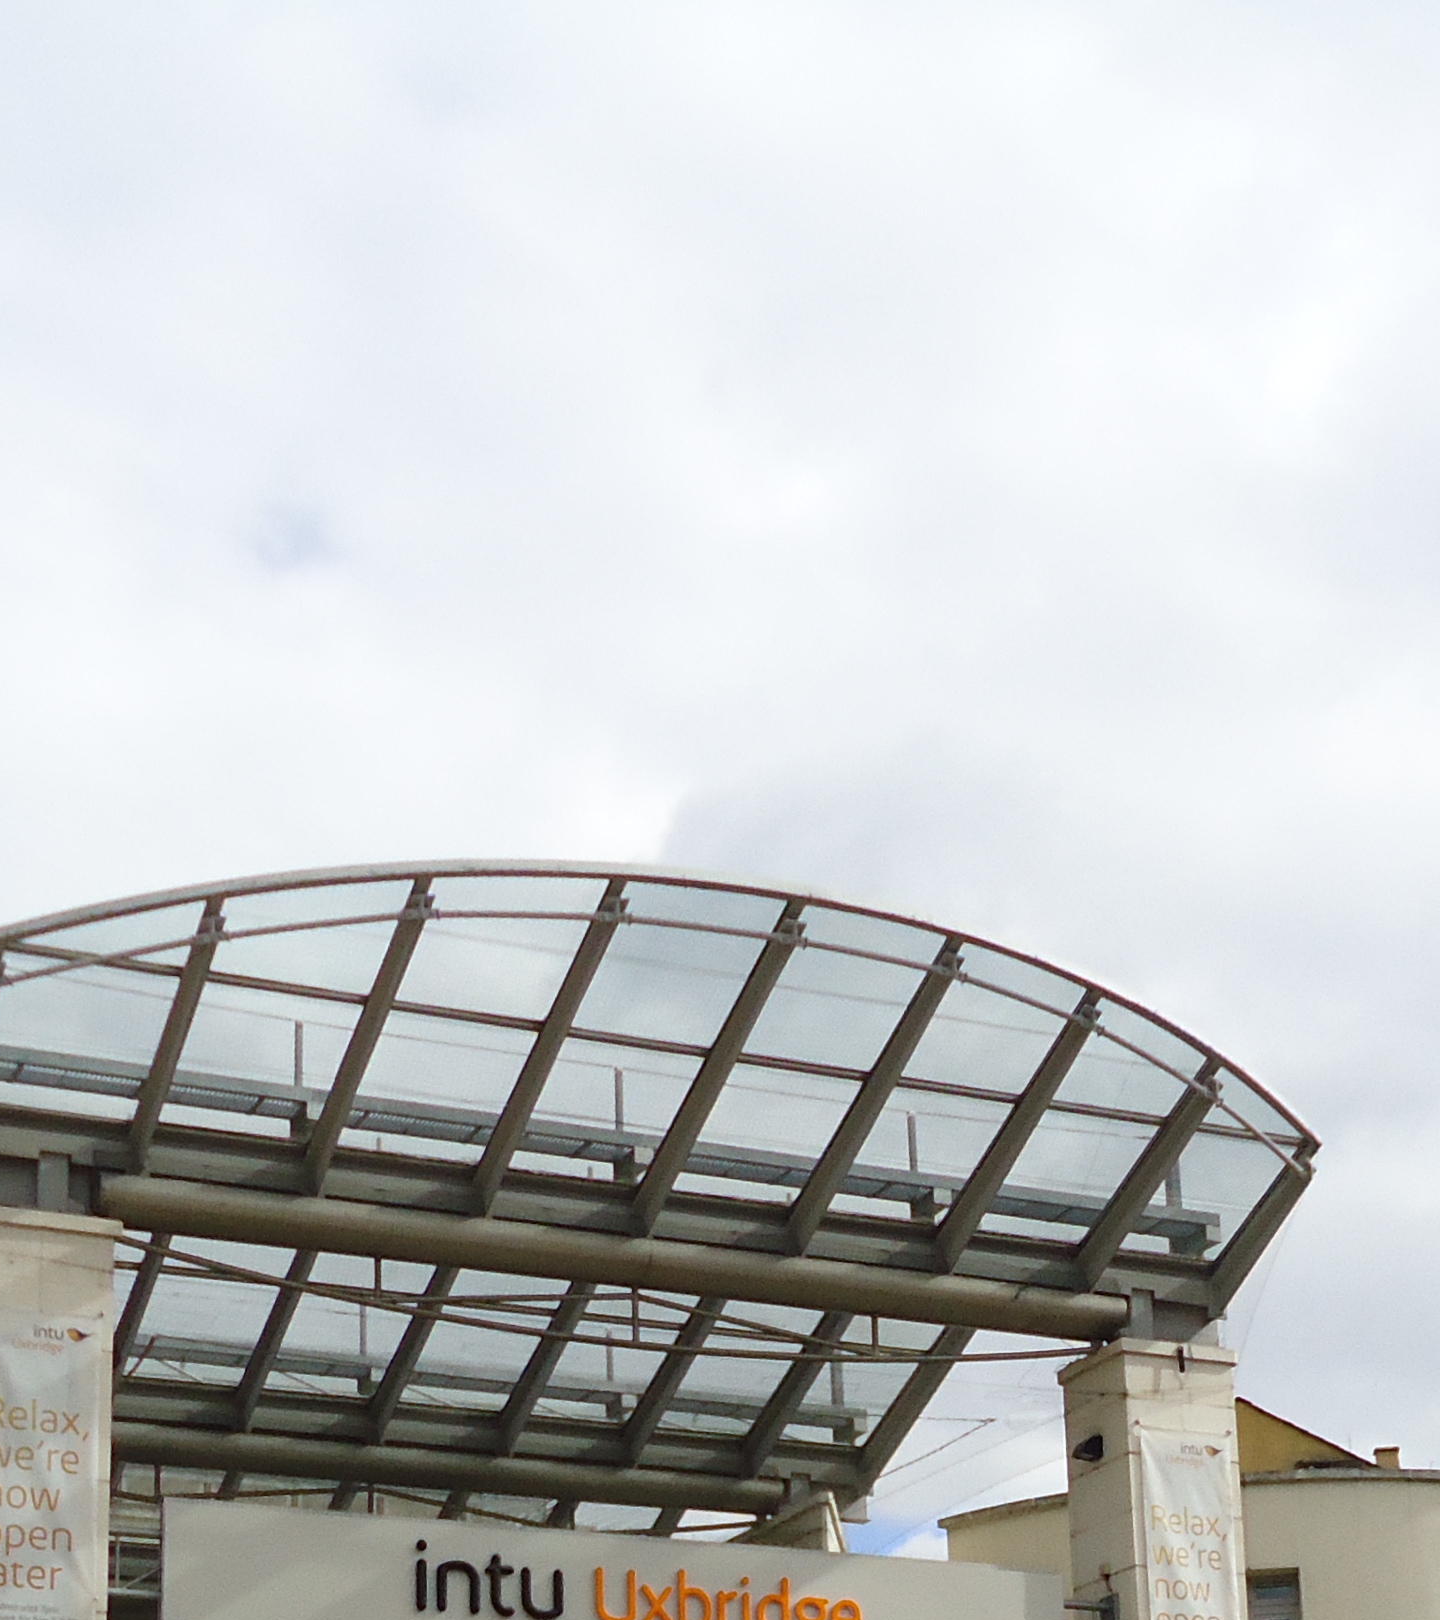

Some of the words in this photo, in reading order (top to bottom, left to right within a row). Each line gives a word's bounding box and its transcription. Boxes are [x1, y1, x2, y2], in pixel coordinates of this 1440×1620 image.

[33, 1323, 65, 1341] intu
[1180, 1441, 1203, 1456] intu
[1151, 1504, 1227, 1541] Relax,
[1155, 1577, 1211, 1603] now
